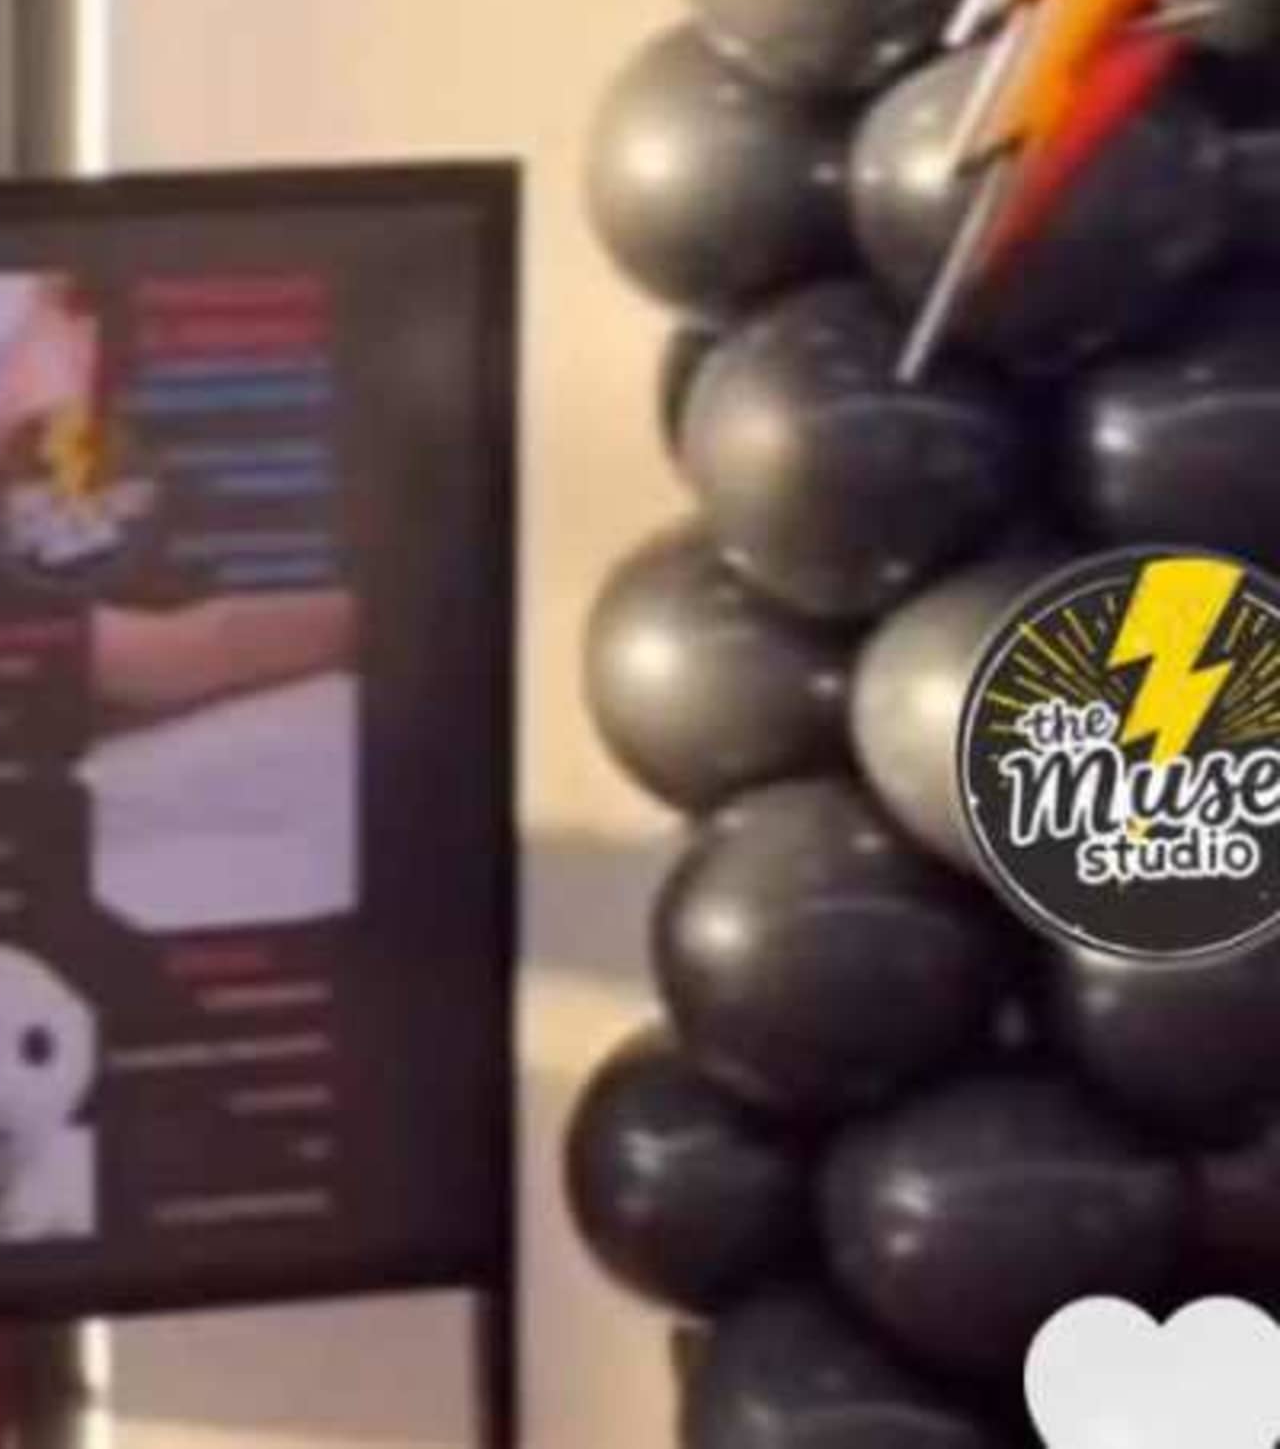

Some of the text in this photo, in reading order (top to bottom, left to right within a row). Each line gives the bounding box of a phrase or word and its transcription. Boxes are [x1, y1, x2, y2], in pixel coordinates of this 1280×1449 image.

[1020, 700, 1116, 746] the
[1002, 748, 1280, 845] Muse
[1080, 829, 1256, 883] studio
